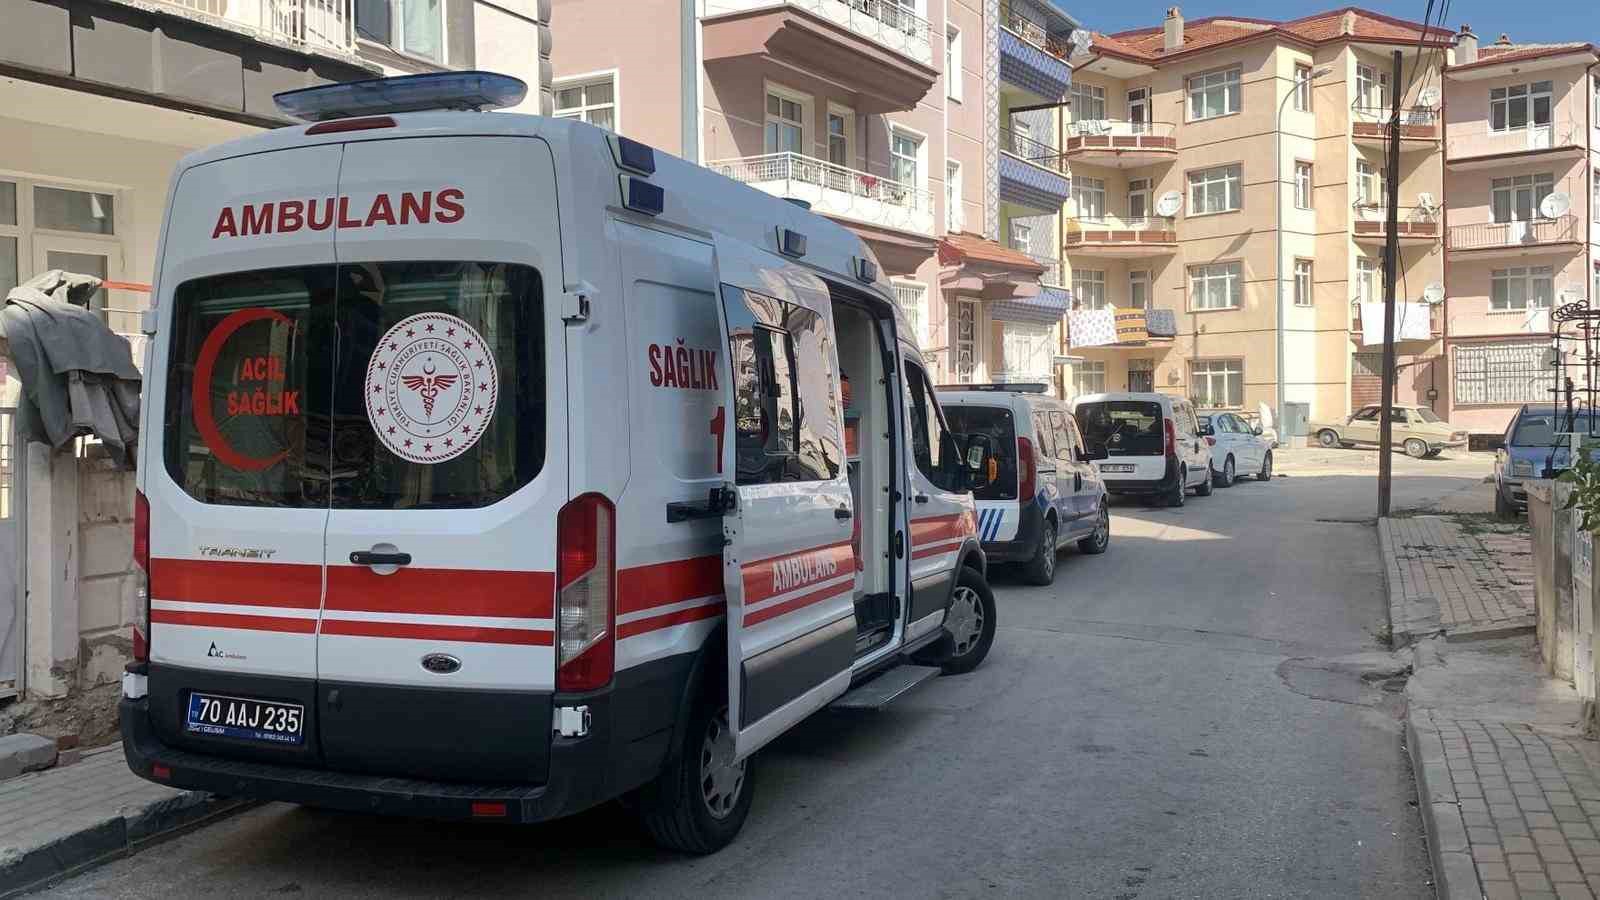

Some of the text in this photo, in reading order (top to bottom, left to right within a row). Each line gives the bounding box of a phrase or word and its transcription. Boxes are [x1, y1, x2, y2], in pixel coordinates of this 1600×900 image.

[212, 187, 466, 240] AMBULANS
[648, 336, 719, 391] SAĞLIK
[227, 386, 300, 416] SAĞLIK
[772, 557, 838, 593] AMBULANS
[199, 698, 221, 723] 70
[225, 702, 260, 728] AAJ
[263, 706, 300, 733] 235
